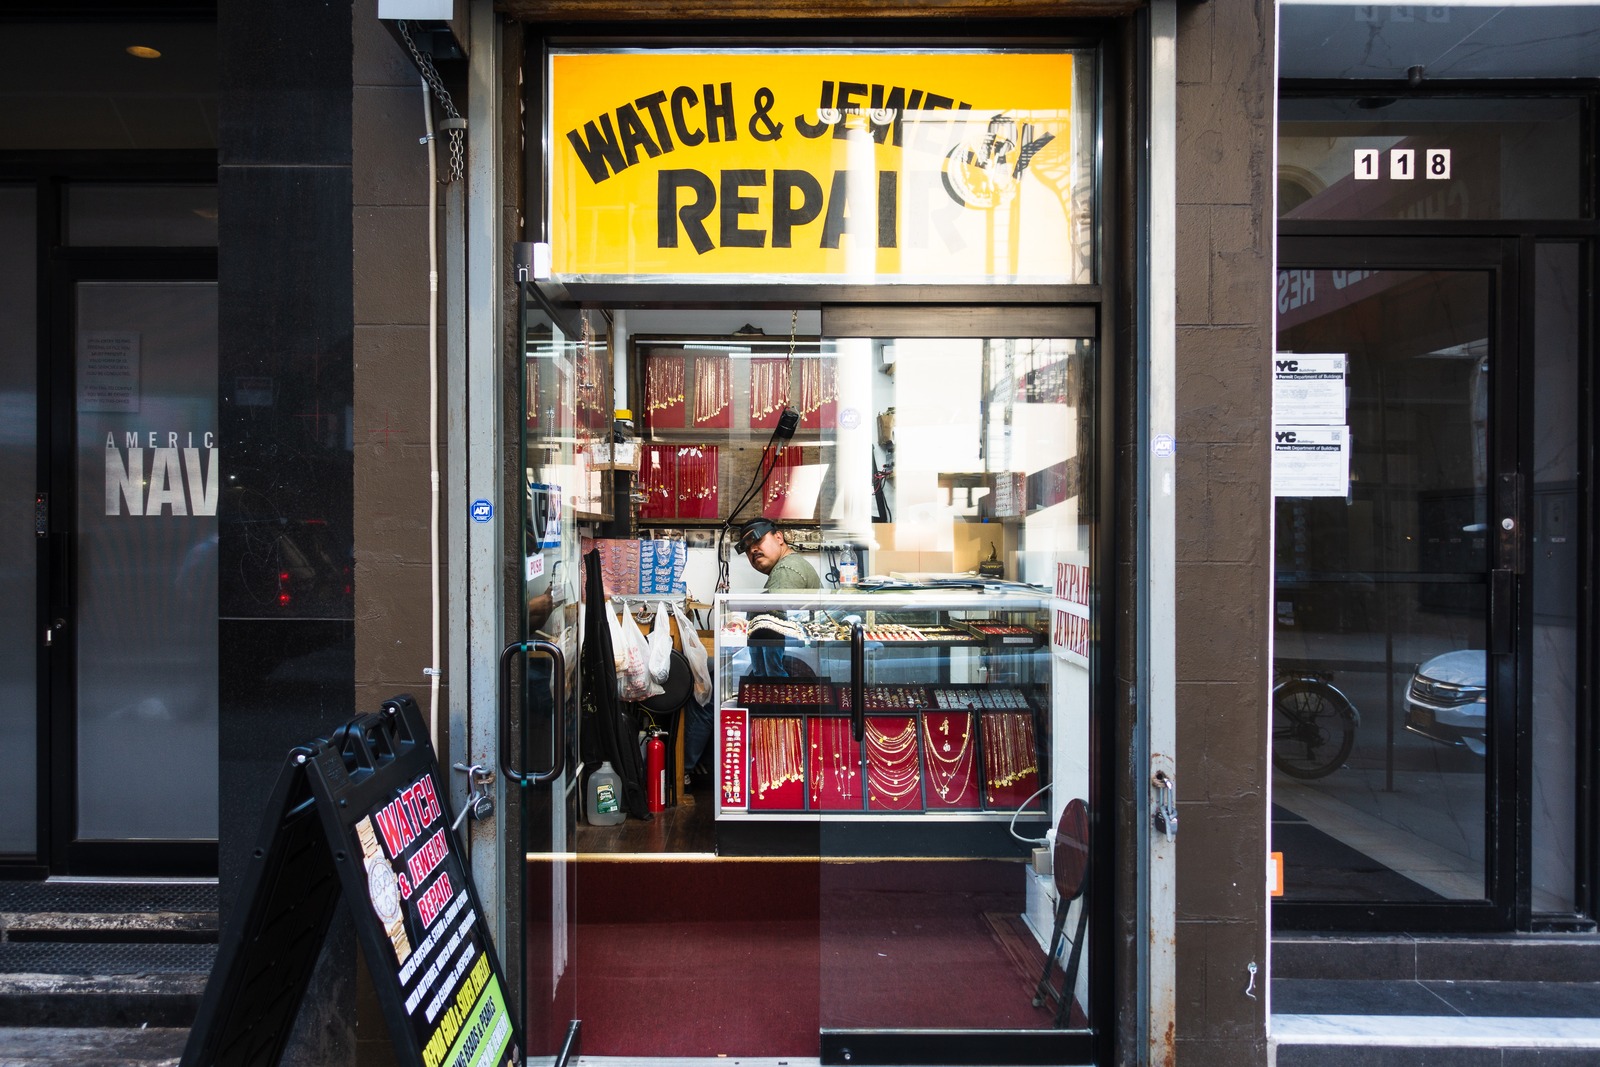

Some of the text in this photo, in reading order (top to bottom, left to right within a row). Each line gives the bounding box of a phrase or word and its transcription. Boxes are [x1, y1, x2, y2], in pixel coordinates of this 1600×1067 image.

[566, 80, 1056, 184] WATCH & JEWELY
[1361, 153, 1446, 175] 118
[657, 168, 967, 255] REPAIR
[106, 432, 214, 448] AMERIC
[105, 448, 219, 516] NAV
[474, 506, 490, 515] ADT
[530, 558, 542, 575] PUSH
[376, 773, 442, 860] WATCH
[398, 826, 449, 900] & JEWELRY
[417, 871, 454, 930] REPAIR
[422, 950, 491, 1067] REPAIR GOLD & SILVER JEWELRY
[477, 1022, 484, 1038] &
[479, 995, 496, 1032] PEARLS
[463, 1026, 480, 1064] BEADS
